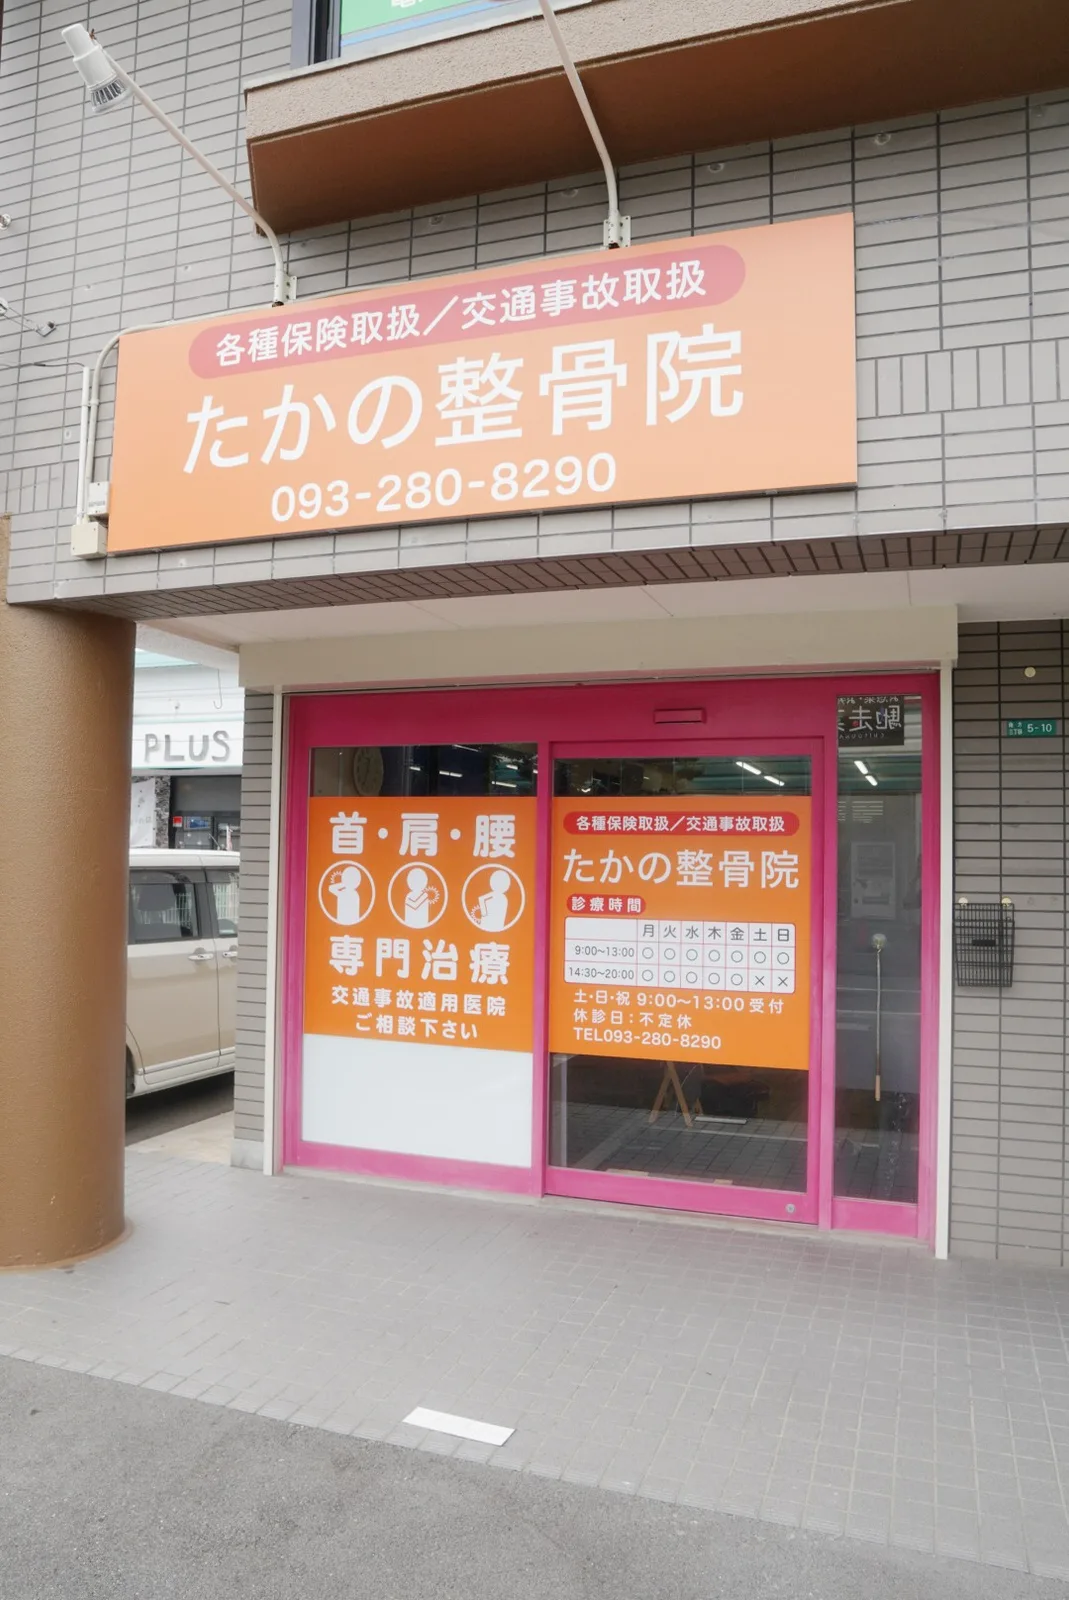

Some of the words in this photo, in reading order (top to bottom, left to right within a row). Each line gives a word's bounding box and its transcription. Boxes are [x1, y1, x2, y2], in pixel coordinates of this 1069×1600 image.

[215, 258, 708, 368] 各種保険取扱／交通事故取扱
[183, 321, 746, 474] たかの整骨院
[270, 452, 618, 523] 093-280-8290
[1027, 723, 1053, 733] 5-10
[144, 730, 230, 763] PLUS
[329, 811, 516, 859] 首・肩・腰
[563, 848, 800, 889] たかの整骨院
[572, 896, 641, 913] 診療時間
[643, 925, 654, 938] 月
[664, 926, 676, 938] 火
[686, 926, 699, 939] 水
[708, 927, 722, 940] 木
[731, 927, 744, 941] 金
[754, 929, 767, 942] 土
[778, 929, 790, 942] 日
[329, 934, 510, 985] 専門治療
[331, 985, 506, 1018] 交通事故適用医院
[750, 998, 784, 1014] 受付
[355, 1012, 478, 1040] ご相談下さい
[574, 1028, 721, 1049] TEL093-280-8290
